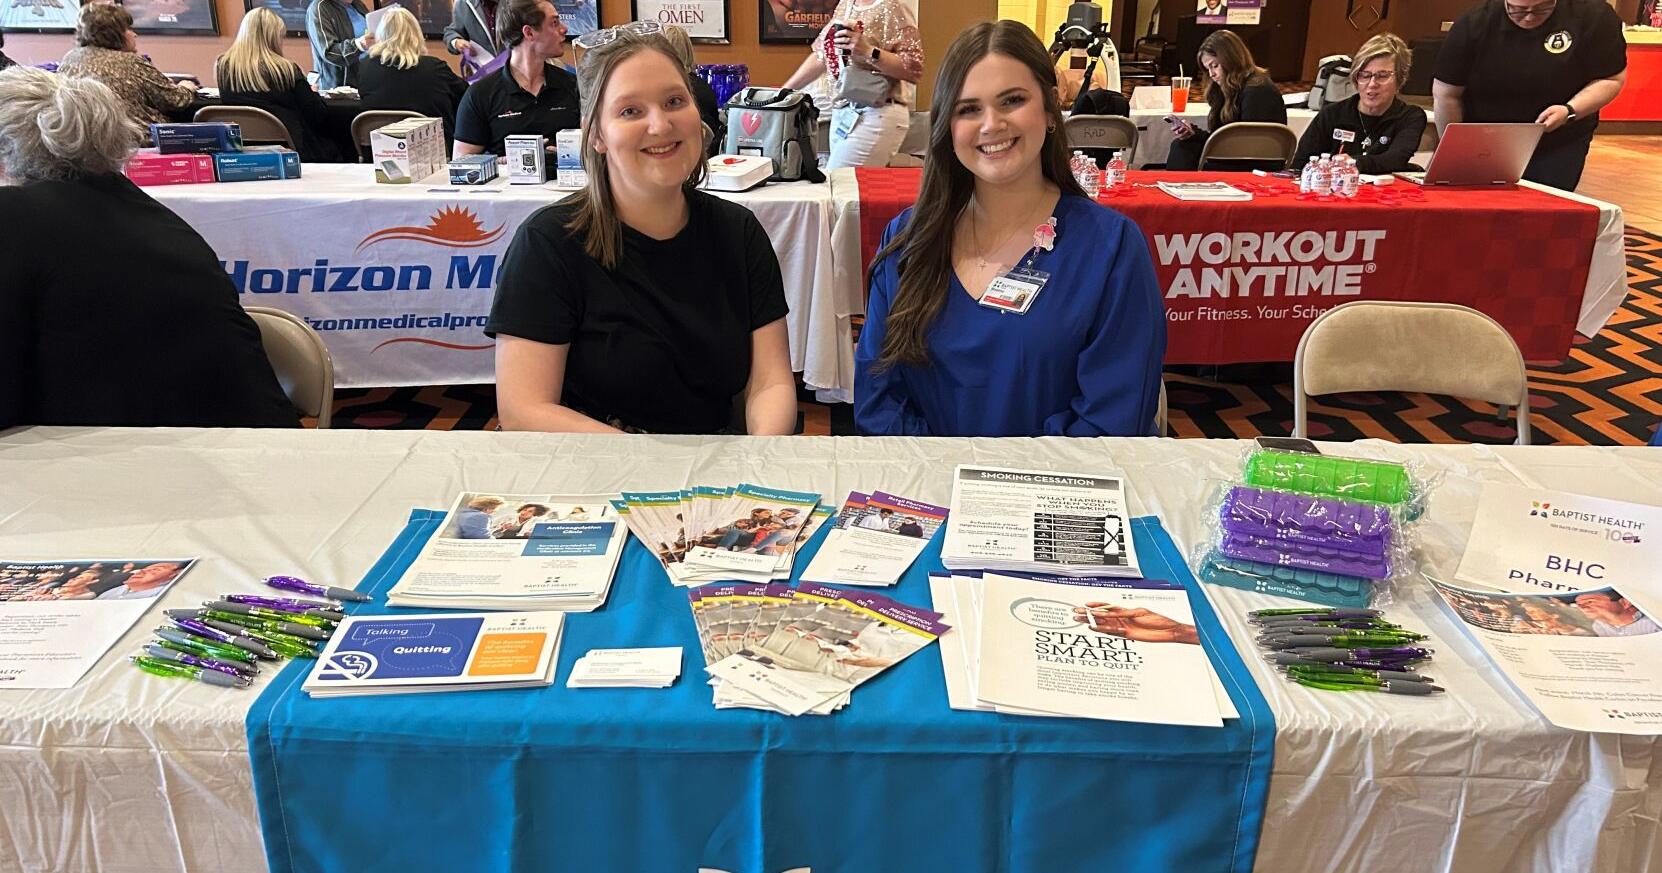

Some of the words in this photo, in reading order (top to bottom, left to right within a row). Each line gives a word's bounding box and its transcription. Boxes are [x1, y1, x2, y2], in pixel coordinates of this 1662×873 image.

[559, 13, 577, 21] STERS
[658, 9, 705, 24] OMEN
[784, 11, 832, 23] GARFIELD
[1153, 229, 1387, 266] WORKOUT
[219, 258, 433, 295] Horizon
[1197, 305, 1252, 321] Fitness.
[1256, 304, 1289, 320] Your
[1291, 304, 1331, 319] Sche
[980, 472, 1032, 482] SMOKING
[1033, 475, 1096, 487] CESSATION
[748, 489, 778, 499] Specialty
[778, 495, 811, 503] Pharmacy
[888, 496, 906, 504] Retail
[906, 500, 935, 511] Pharmacy
[896, 502, 921, 511] Services
[1552, 508, 1597, 523] BAPTIST
[1598, 515, 1643, 530] HEALTH
[1546, 554, 1606, 580] BHC
[1267, 585, 1287, 593] BAPTIST
[1286, 588, 1307, 597] HEALTH
[878, 607, 907, 623] DELIVERY
[906, 617, 934, 631] SERVICE
[889, 607, 933, 626] PRESCRIPTION
[366, 628, 409, 636] Talking
[1035, 630, 1135, 651] START
[393, 645, 453, 655] Quitting
[1035, 642, 1143, 664] SMART:
[1037, 654, 1075, 665] PLAN
[1079, 659, 1099, 667] TO
[1103, 662, 1140, 671] QUIT
